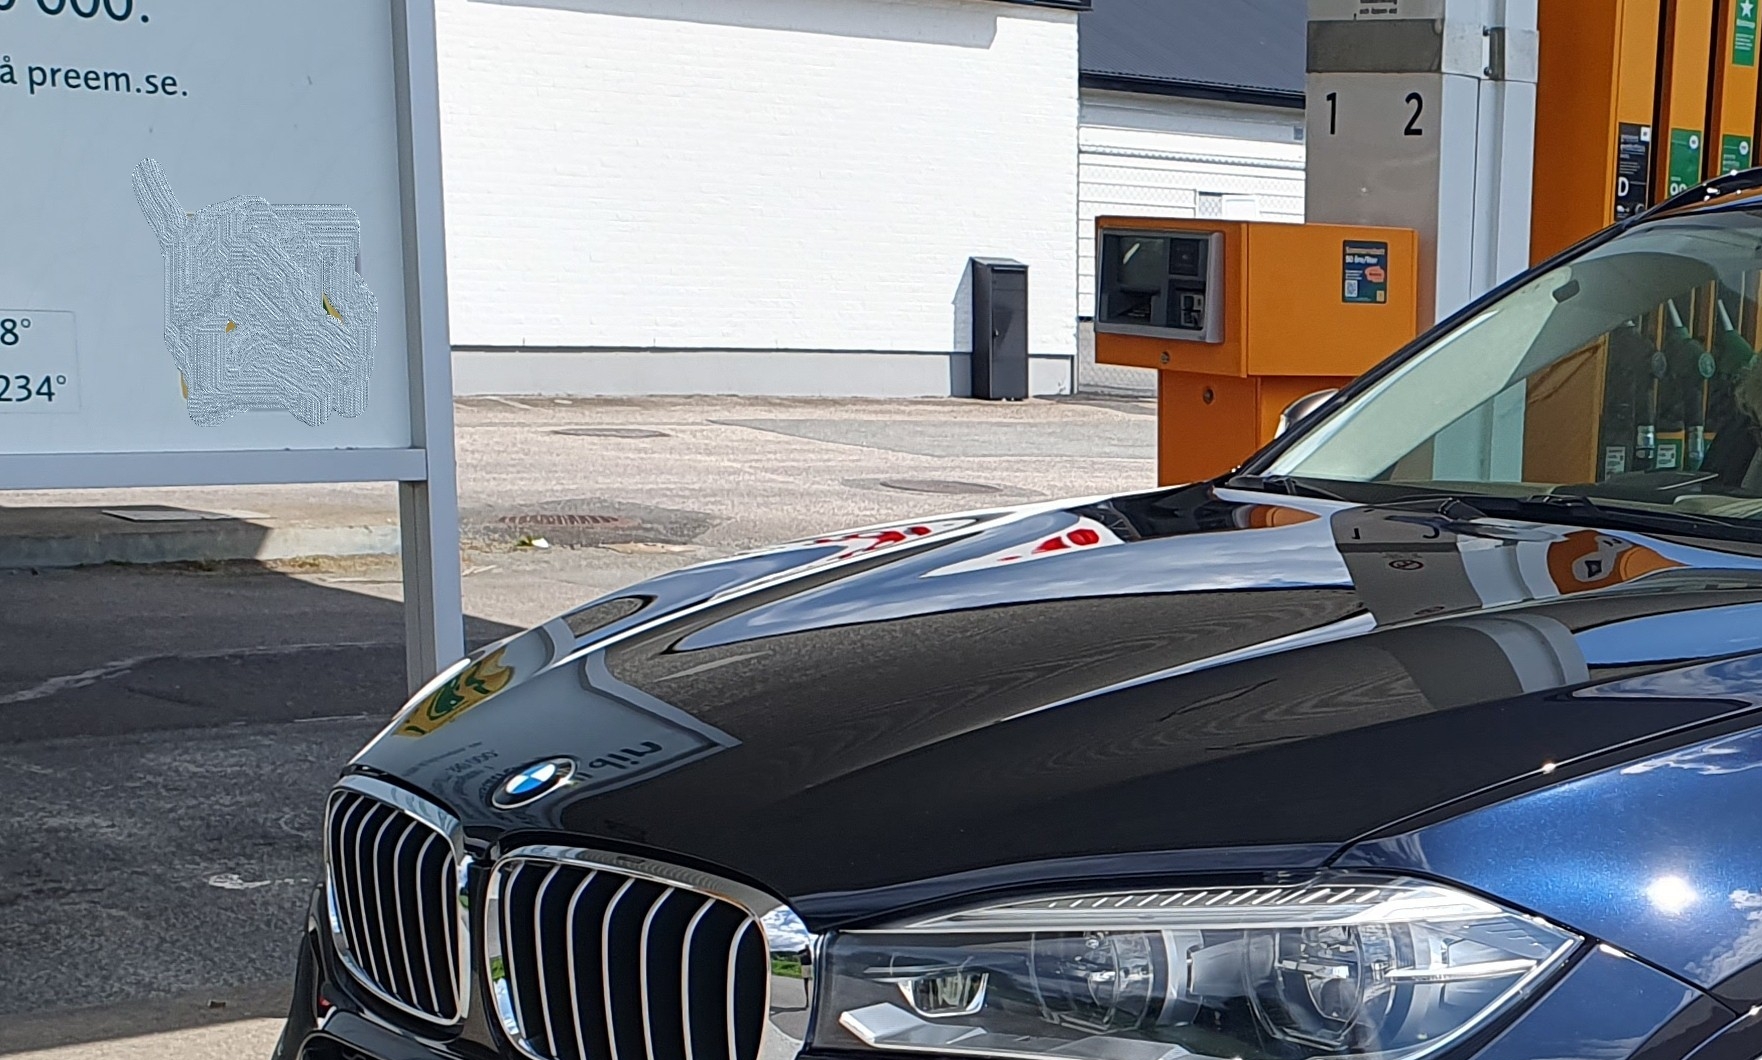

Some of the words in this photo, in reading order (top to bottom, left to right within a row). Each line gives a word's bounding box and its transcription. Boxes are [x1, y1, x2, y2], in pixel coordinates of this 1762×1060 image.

[28, 66, 188, 97] preem.se.
[1326, 92, 1337, 135] 1
[1403, 92, 1423, 136] 2
[1617, 177, 1629, 197] D
